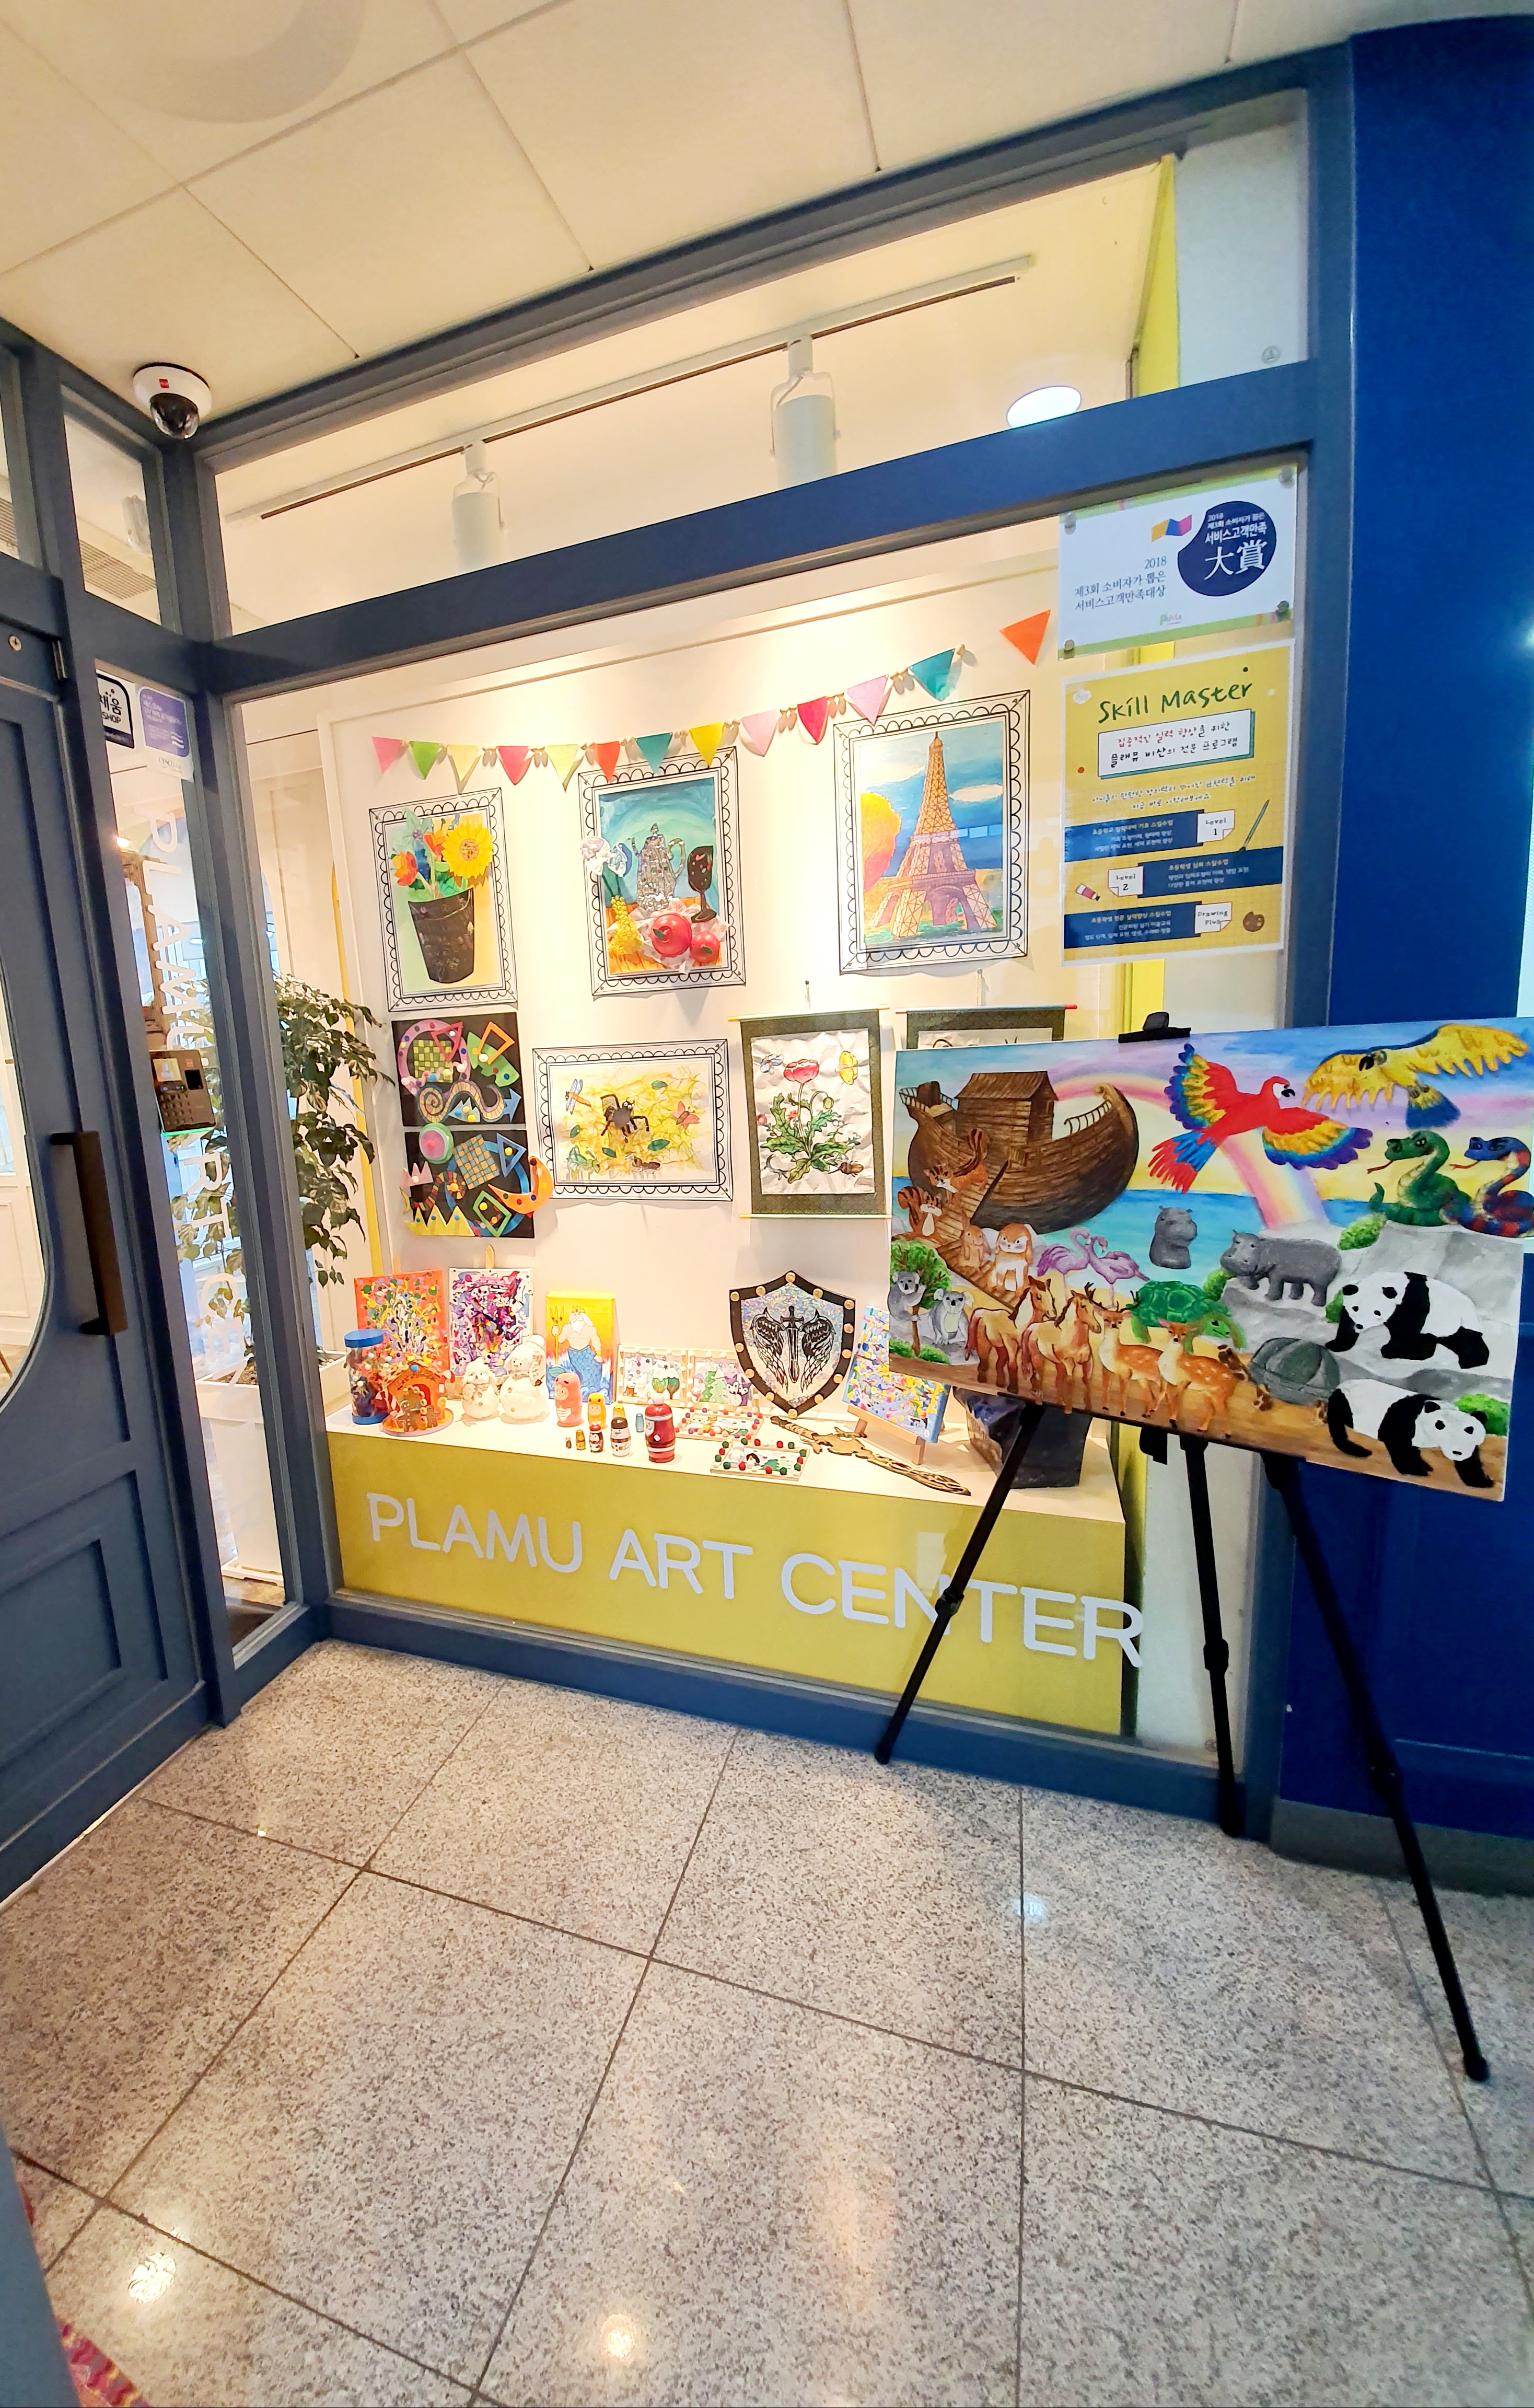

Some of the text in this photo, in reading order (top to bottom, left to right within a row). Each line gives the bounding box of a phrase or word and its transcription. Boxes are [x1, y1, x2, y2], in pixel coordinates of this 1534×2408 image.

[1207, 513, 1224, 522] 2018
[1204, 521, 1268, 545] 서비스고객만족
[1144, 555, 1167, 570] 2018
[1204, 539, 1268, 581] 大賞
[1075, 570, 1166, 597] 제3회 소비자가 뽑은
[1075, 585, 1167, 612] 서비스고객만족대상
[1098, 682, 1253, 724] Skill Master
[1118, 721, 1230, 748] 집중적인 실력 향상을 위한
[1111, 737, 1238, 768] 플래뮤 비산의 전문 프로그램
[367, 1492, 1143, 1668] PLAMU ART CENTER
